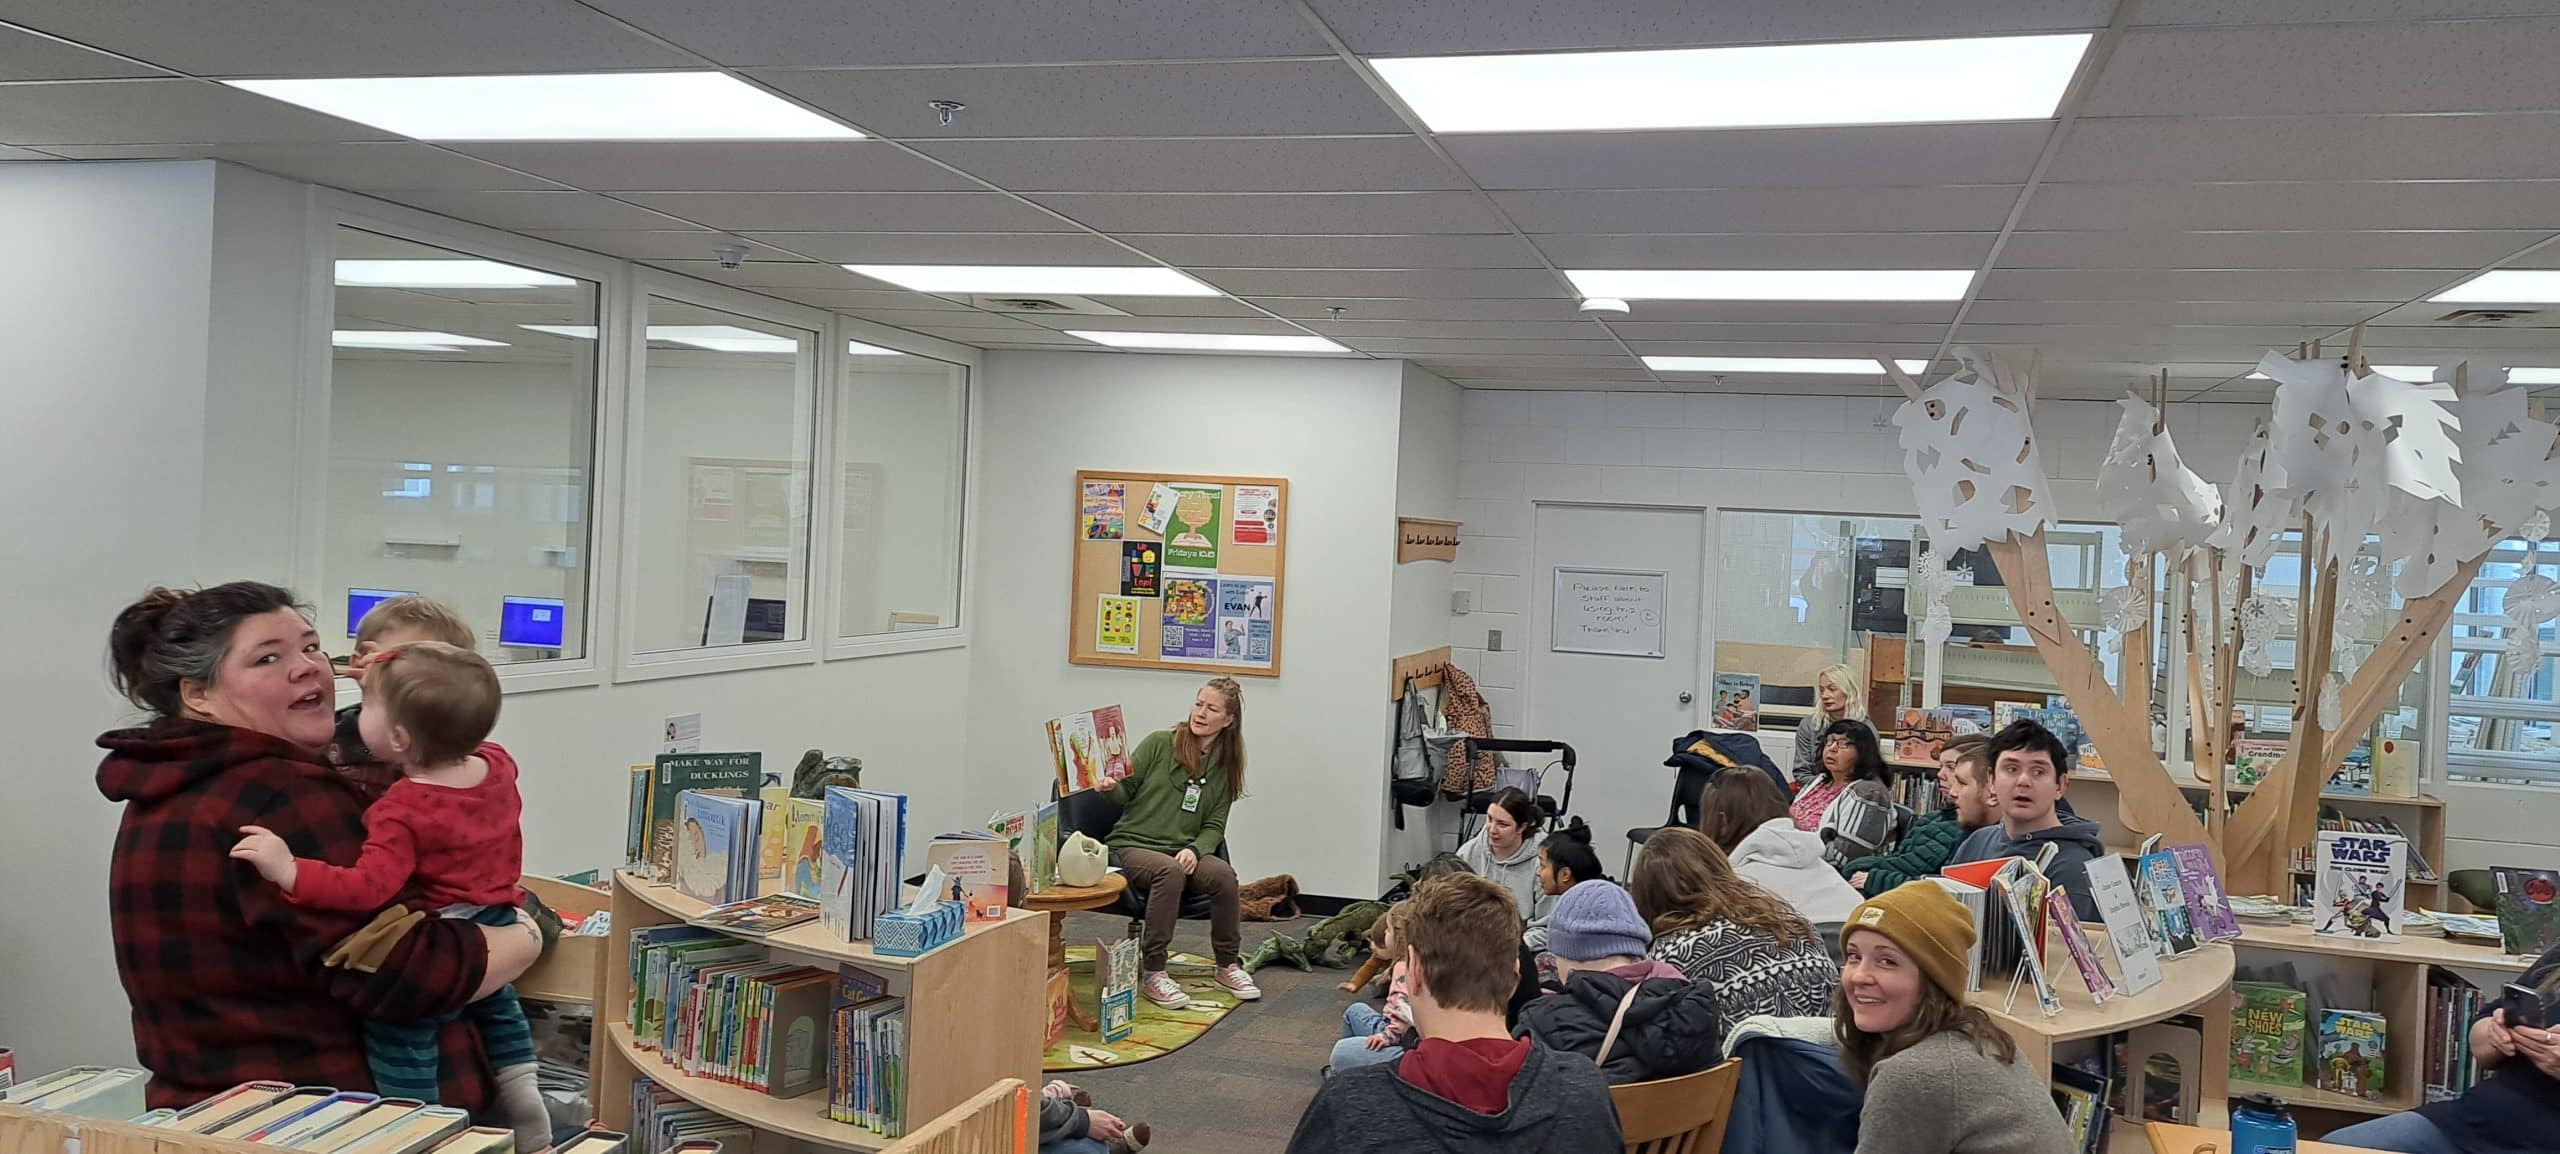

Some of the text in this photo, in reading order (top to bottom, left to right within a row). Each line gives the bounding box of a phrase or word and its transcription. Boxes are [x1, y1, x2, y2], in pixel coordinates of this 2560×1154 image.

[1224, 602, 1251, 611] EVAN
[670, 757, 749, 768] MAKE WAY FOR
[690, 770, 749, 780] DUCKLINGS
[2331, 836, 2391, 852] STAR
[2331, 847, 2391, 863] WARS
[2249, 1008, 2283, 1022] NEW
[2247, 1020, 2282, 1036] SHOES
[2335, 1017, 2374, 1031] STAR
[2335, 1025, 2374, 1039] WARS
